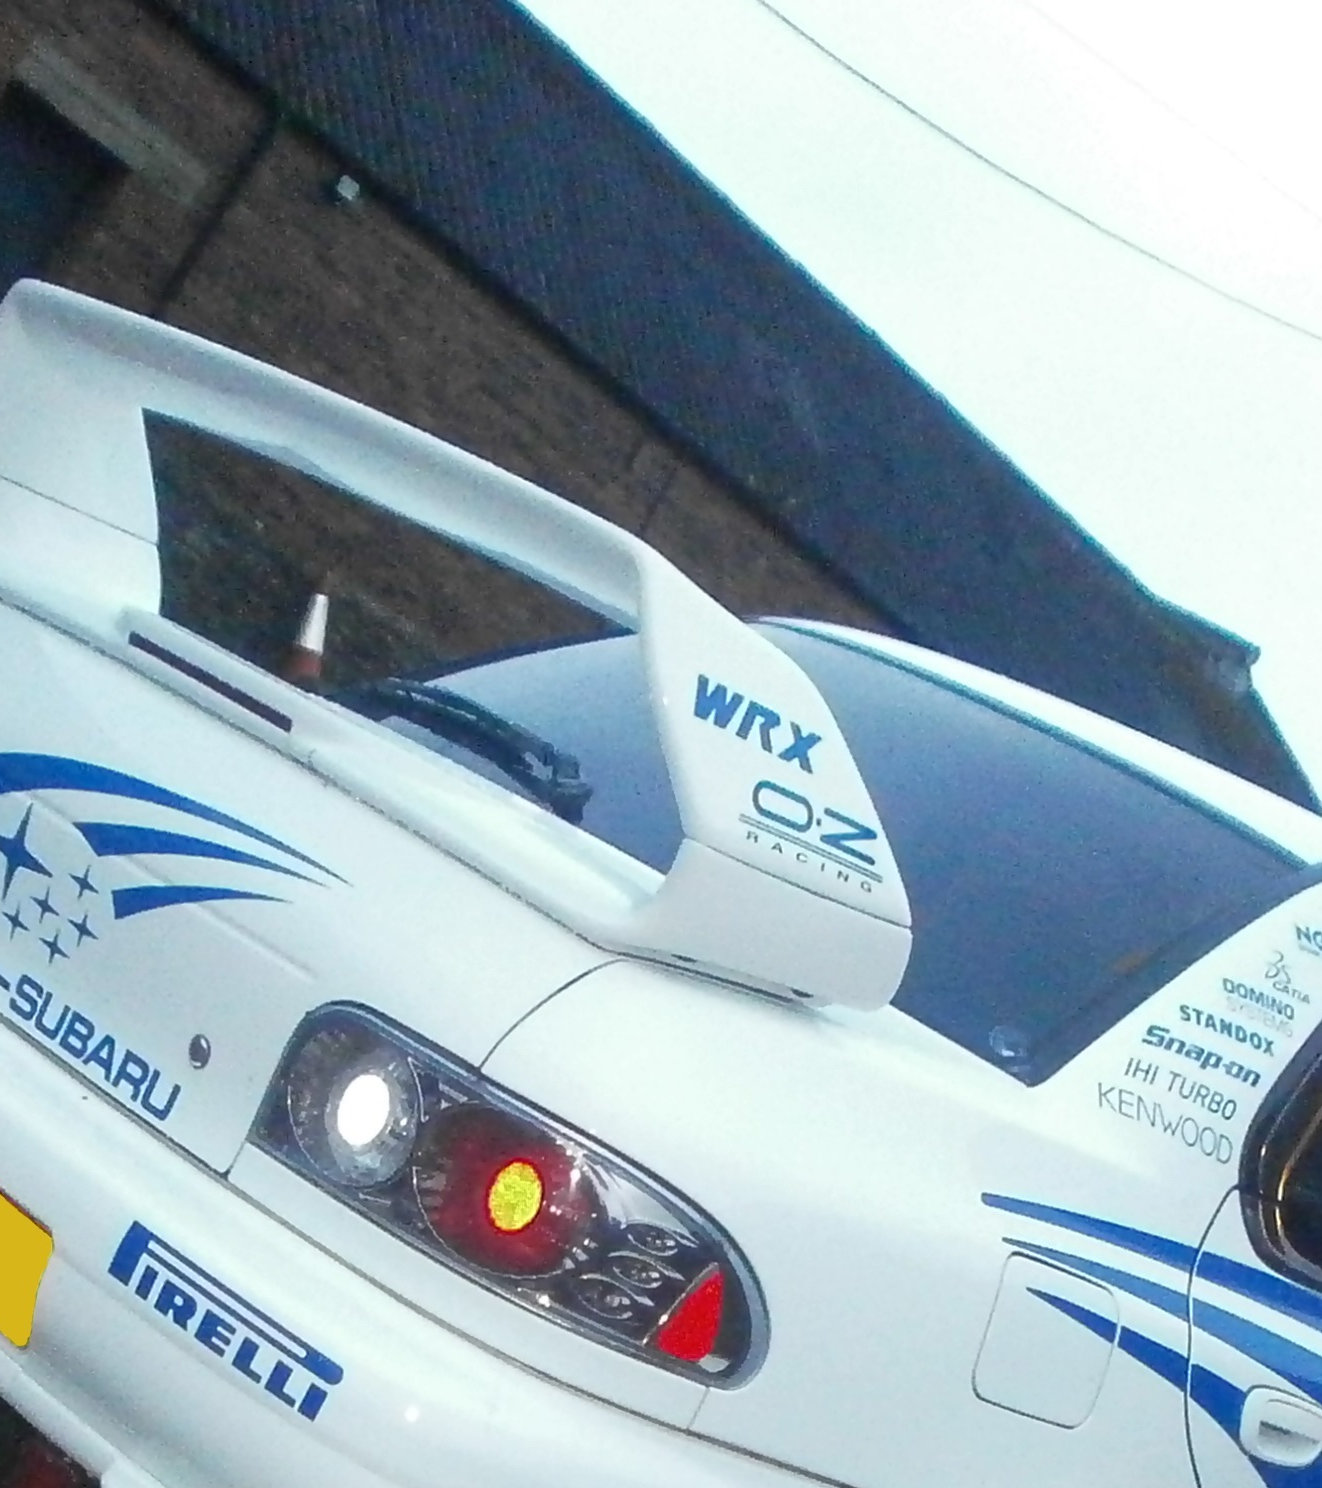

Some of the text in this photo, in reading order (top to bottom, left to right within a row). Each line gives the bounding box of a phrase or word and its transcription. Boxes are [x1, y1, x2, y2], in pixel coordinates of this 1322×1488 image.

[694, 674, 822, 774] WRX
[745, 831, 873, 893] RACING
[1222, 977, 1295, 1020] DOMINO
[1272, 981, 1311, 1005] CATIA
[7, 974, 182, 1122] SUBARU
[1141, 1024, 1262, 1088] Snap-on
[1179, 1003, 1275, 1057] STANDOX
[1124, 1057, 1238, 1121] IHI TURBO
[1097, 1081, 1234, 1165] KENWOOD
[107, 1220, 344, 1423] PIRELLI
